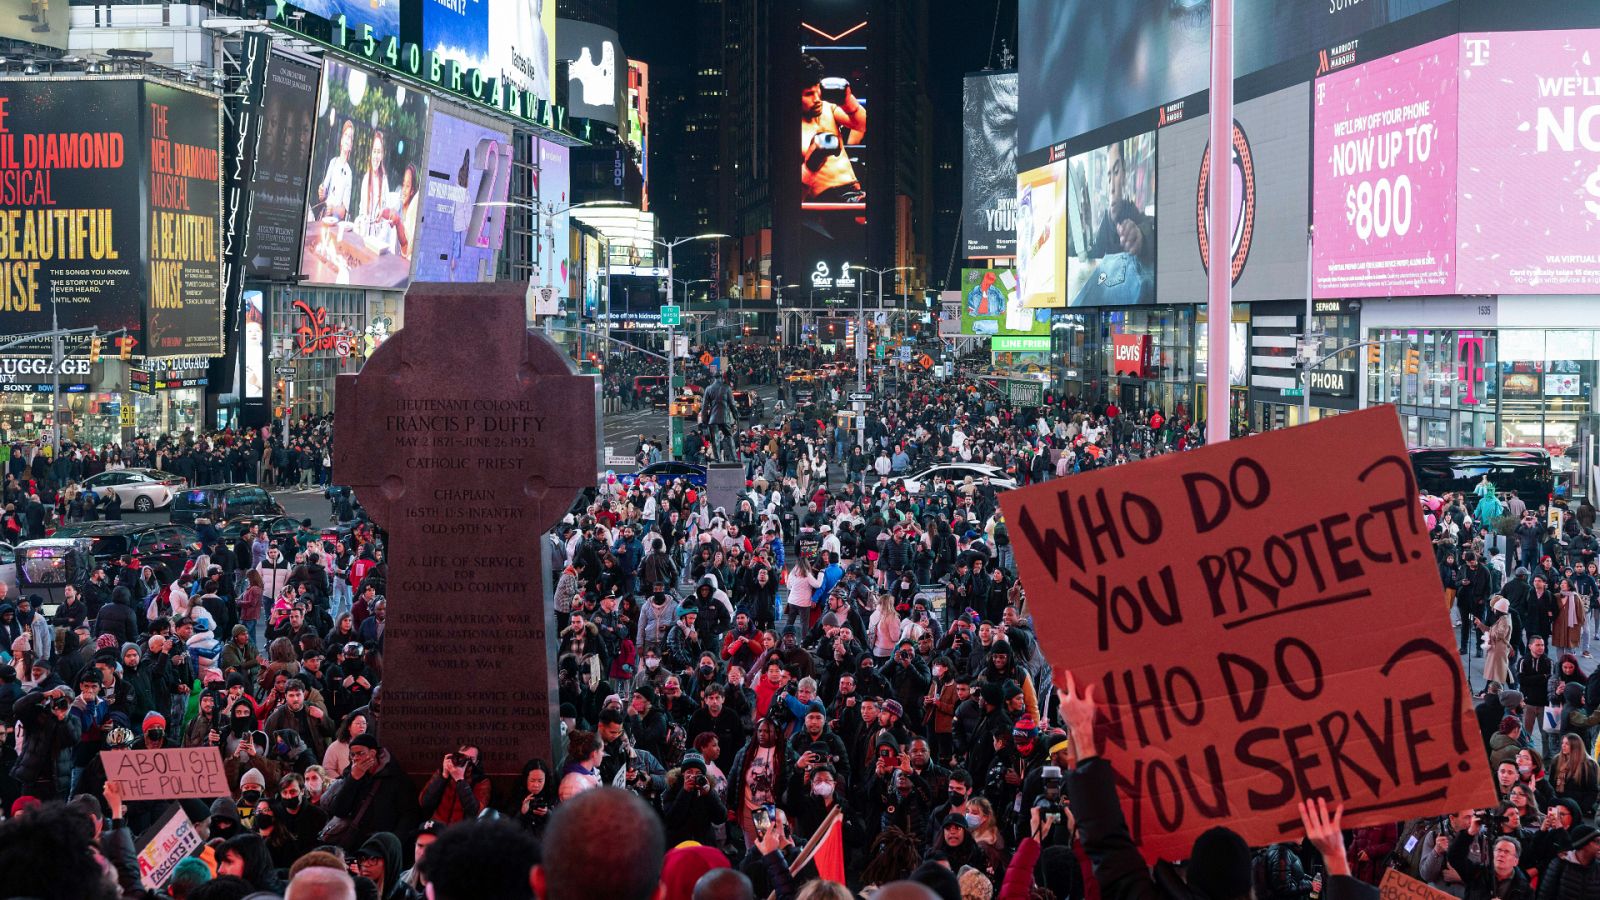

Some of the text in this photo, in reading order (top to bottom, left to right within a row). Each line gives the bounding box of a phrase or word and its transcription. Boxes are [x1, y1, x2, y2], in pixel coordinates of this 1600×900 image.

[1331, 39, 1359, 57] MARRIOTT
[1331, 53, 1356, 68] MARQUIS
[337, 14, 566, 131] 1540 BROADWAY
[151, 103, 169, 140] THE
[1354, 114, 1367, 133] PAY
[1367, 111, 1381, 130] OFF
[1381, 106, 1402, 127] YOUR
[1402, 100, 1431, 121] PHONE
[23, 133, 124, 169] DIAMOND
[1333, 122, 1434, 178] NOW UP TO
[151, 138, 174, 176] NEIL
[174, 143, 218, 181] DIAMOND
[614, 151, 623, 186] 1500
[151, 173, 190, 211] MUSICAL
[1346, 173, 1412, 241] $800
[986, 209, 1017, 232] YOUR
[0, 208, 119, 261] BEAUTIFUL
[151, 211, 217, 263] A BEAUTIFUL
[1545, 255, 1596, 265] VIA VIRTUAL
[75, 287, 101, 295] HEARD,
[151, 260, 184, 310] NOISE
[1315, 302, 1340, 312] SEPHORA
[1478, 305, 1491, 315] 1535
[65, 335, 108, 343] THEAE
[1001, 340, 1023, 348] LINE
[172, 356, 210, 370] LUGGAGE
[1300, 372, 1344, 390] SPHORA
[396, 399, 534, 413] LIEUTENANT COLONEL
[386, 415, 459, 432] FRANCIS
[484, 415, 547, 432] DUFFY
[394, 436, 417, 449] MAY
[494, 437, 508, 448] 26
[511, 437, 536, 449] 1932
[406, 457, 524, 470] CATHOLIC PRIEST
[433, 488, 497, 501] CHAPLAIN
[468, 508, 524, 519] INFANTRY
[1019, 456, 1272, 583] WHO DO
[422, 523, 447, 535] OLD
[451, 523, 480, 535] 69TH
[1070, 454, 1424, 652] YOU PROTECT?
[407, 556, 526, 568] A LIFE OF SERVICE
[454, 570, 476, 579] FOR
[403, 581, 529, 592] GOD AND COUNTRY
[399, 613, 531, 625] SPANISH AMERICAN WAR
[385, 628, 545, 640] NEW YORK NATIONAL GUARD
[414, 644, 514, 655] MEXICAN BORDER
[427, 659, 503, 670] WORLD WAR
[382, 691, 547, 702] DISTINGUISHED SERVICE CROSS
[1092, 635, 1325, 756] WHO DO
[381, 706, 548, 717] DISTINGUISHED SERVICE MEDAL
[382, 721, 548, 732] CONSPICUOUS SERVICE CROSS
[409, 736, 450, 747] LEGION
[1110, 637, 1470, 855] YOU SERVE?
[117, 750, 220, 777] ABOLISH
[112, 774, 225, 797] THE POLICE
